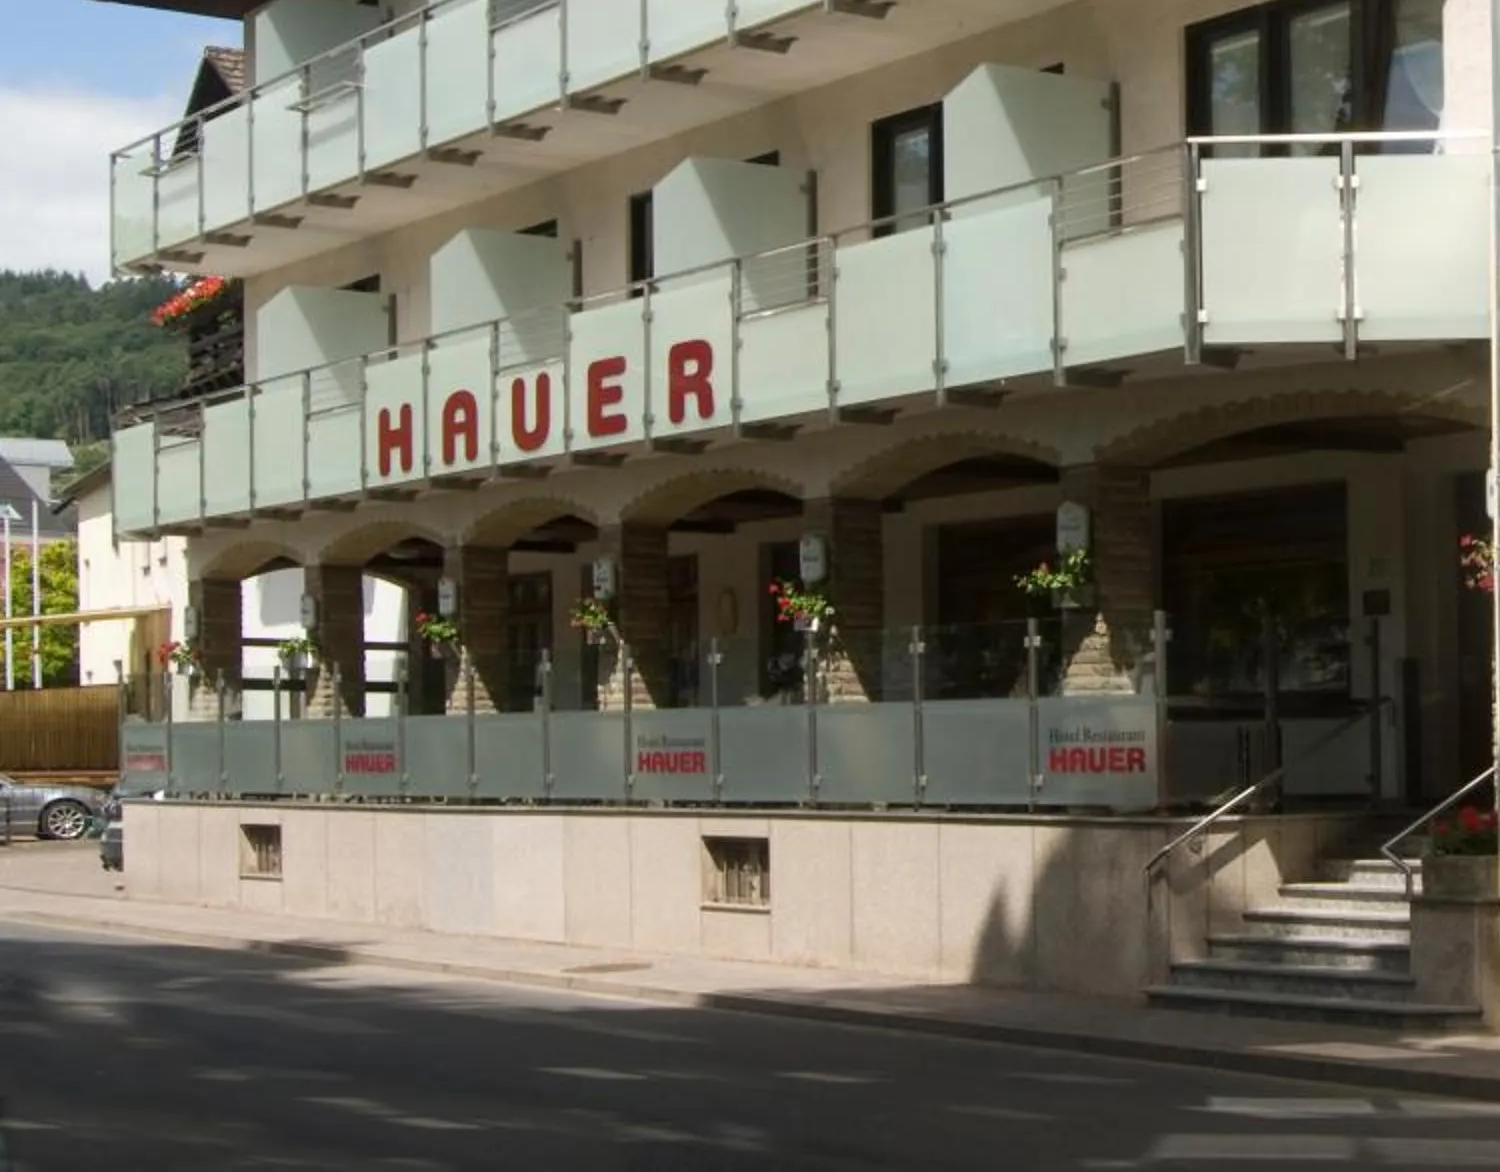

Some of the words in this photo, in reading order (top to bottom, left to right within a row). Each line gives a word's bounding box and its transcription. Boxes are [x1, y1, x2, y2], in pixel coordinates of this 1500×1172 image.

[378, 339, 715, 478] HAUER
[345, 754, 396, 774] HAUER
[637, 751, 706, 774] HAUER
[1048, 747, 1146, 774] HAUER
